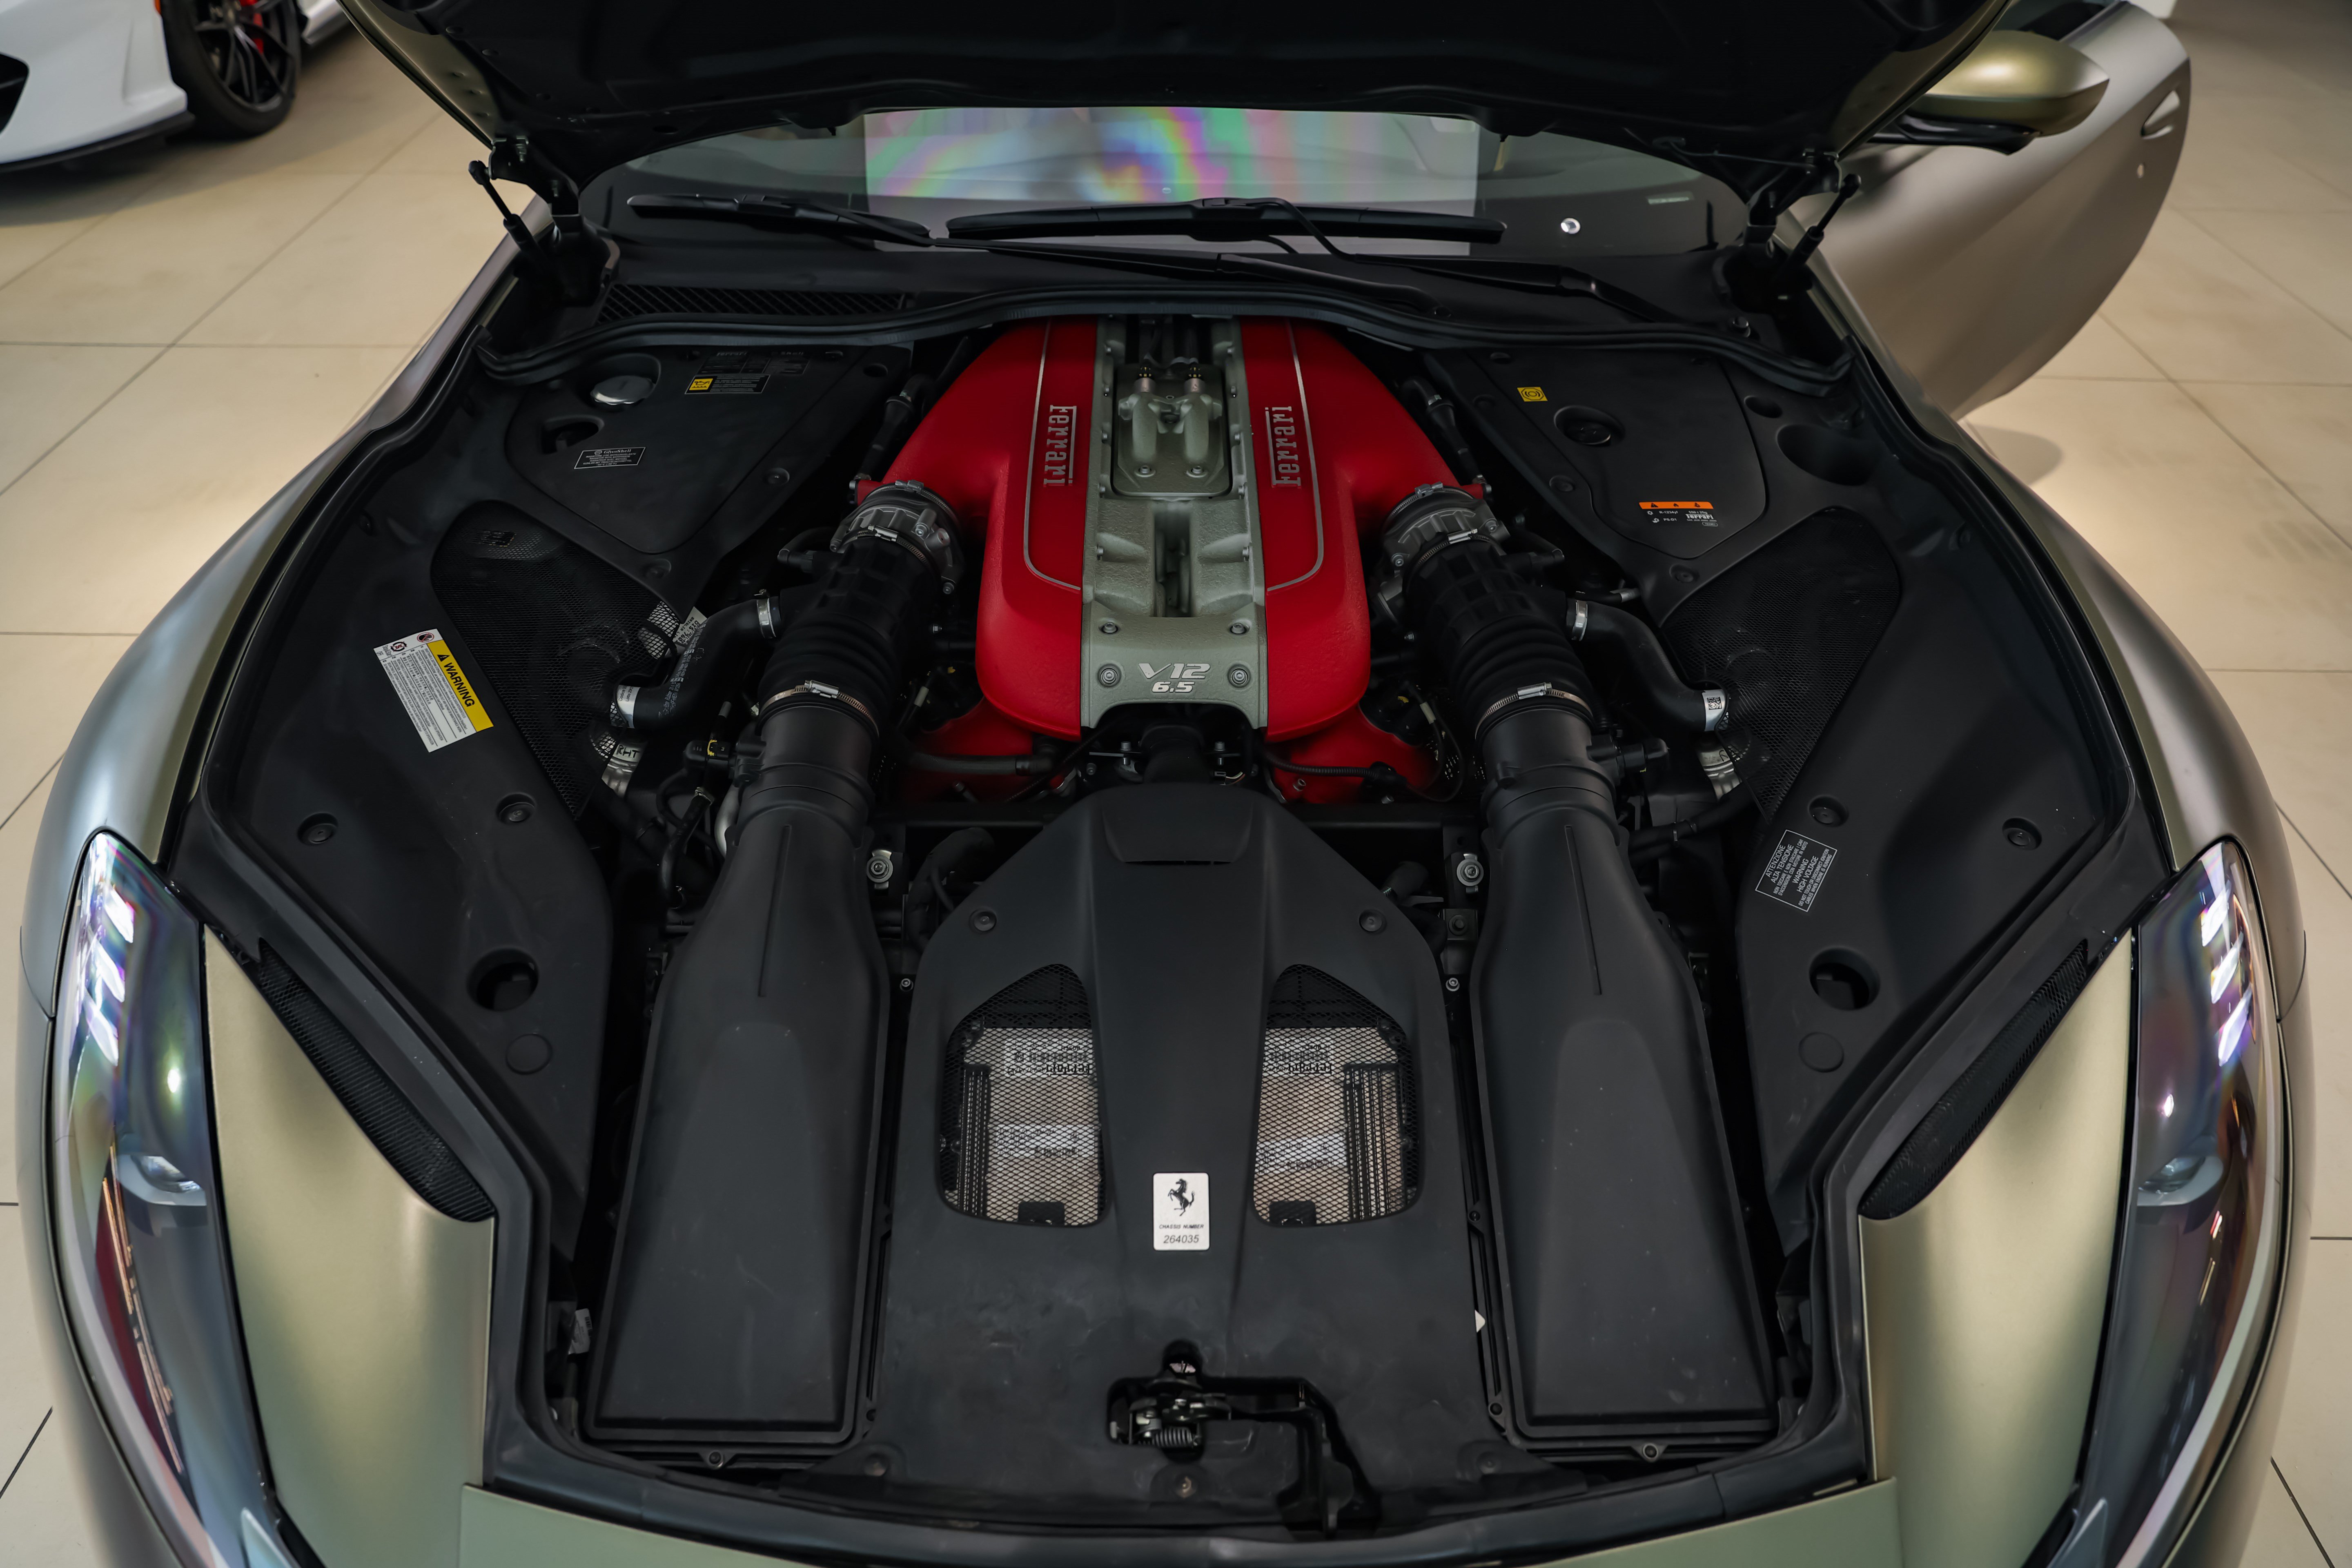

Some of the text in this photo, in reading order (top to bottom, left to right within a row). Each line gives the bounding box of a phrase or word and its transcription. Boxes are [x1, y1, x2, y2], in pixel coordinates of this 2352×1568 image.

[1043, 405, 1077, 484] Ferrari
[1265, 406, 1301, 486] Ferrari
[443, 662, 476, 707] WARNING
[1138, 663, 1211, 679] V12
[1152, 681, 1195, 693] 6.5
[616, 744, 640, 758] RHT
[1766, 844, 1786, 877] ATTENZIONE
[1771, 844, 1794, 883] ALTA TENSIONE
[1793, 858, 1809, 884] WARNING
[1797, 856, 1818, 892] HIGH VOLTAGE
[1163, 1234, 1199, 1244] 264035
